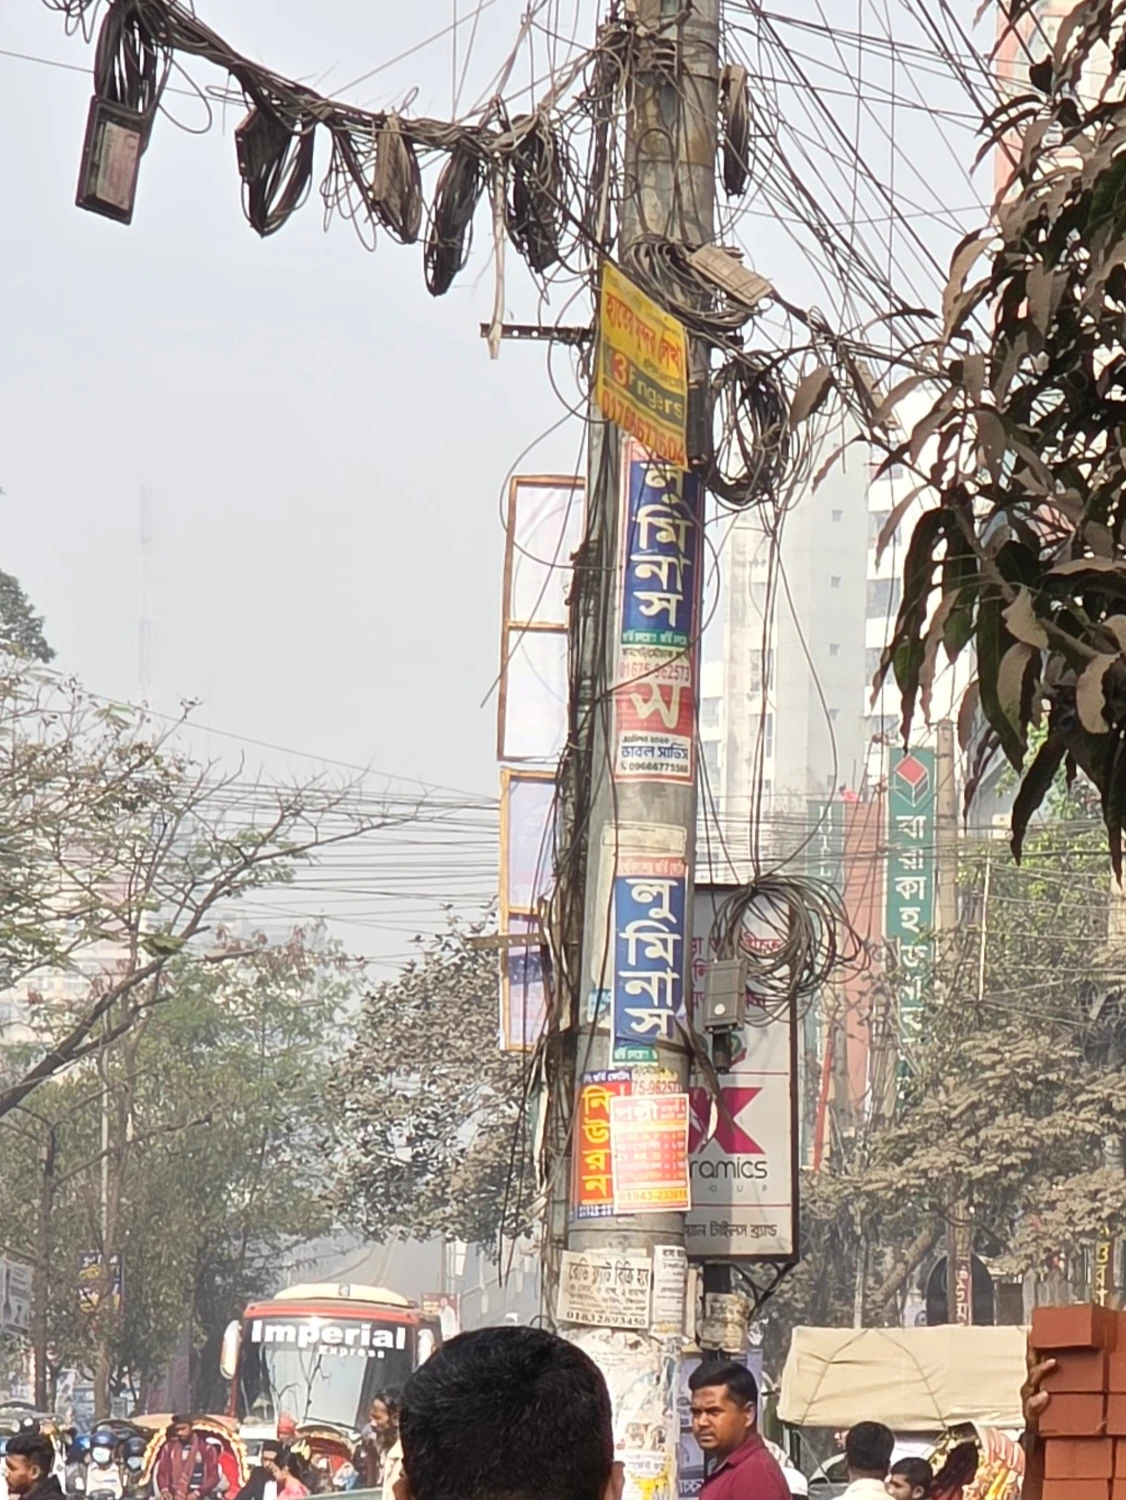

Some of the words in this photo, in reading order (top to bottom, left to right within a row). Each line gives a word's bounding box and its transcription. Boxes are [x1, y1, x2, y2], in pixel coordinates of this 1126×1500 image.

[629, 368, 684, 416] Fngers
[619, 661, 690, 683] 01675962573
[618, 878, 681, 1036] লুমিনাস
[689, 1157, 768, 1179] ramics
[710, 1220, 747, 1238] টাইলস
[251, 1319, 406, 1350] Imperial
